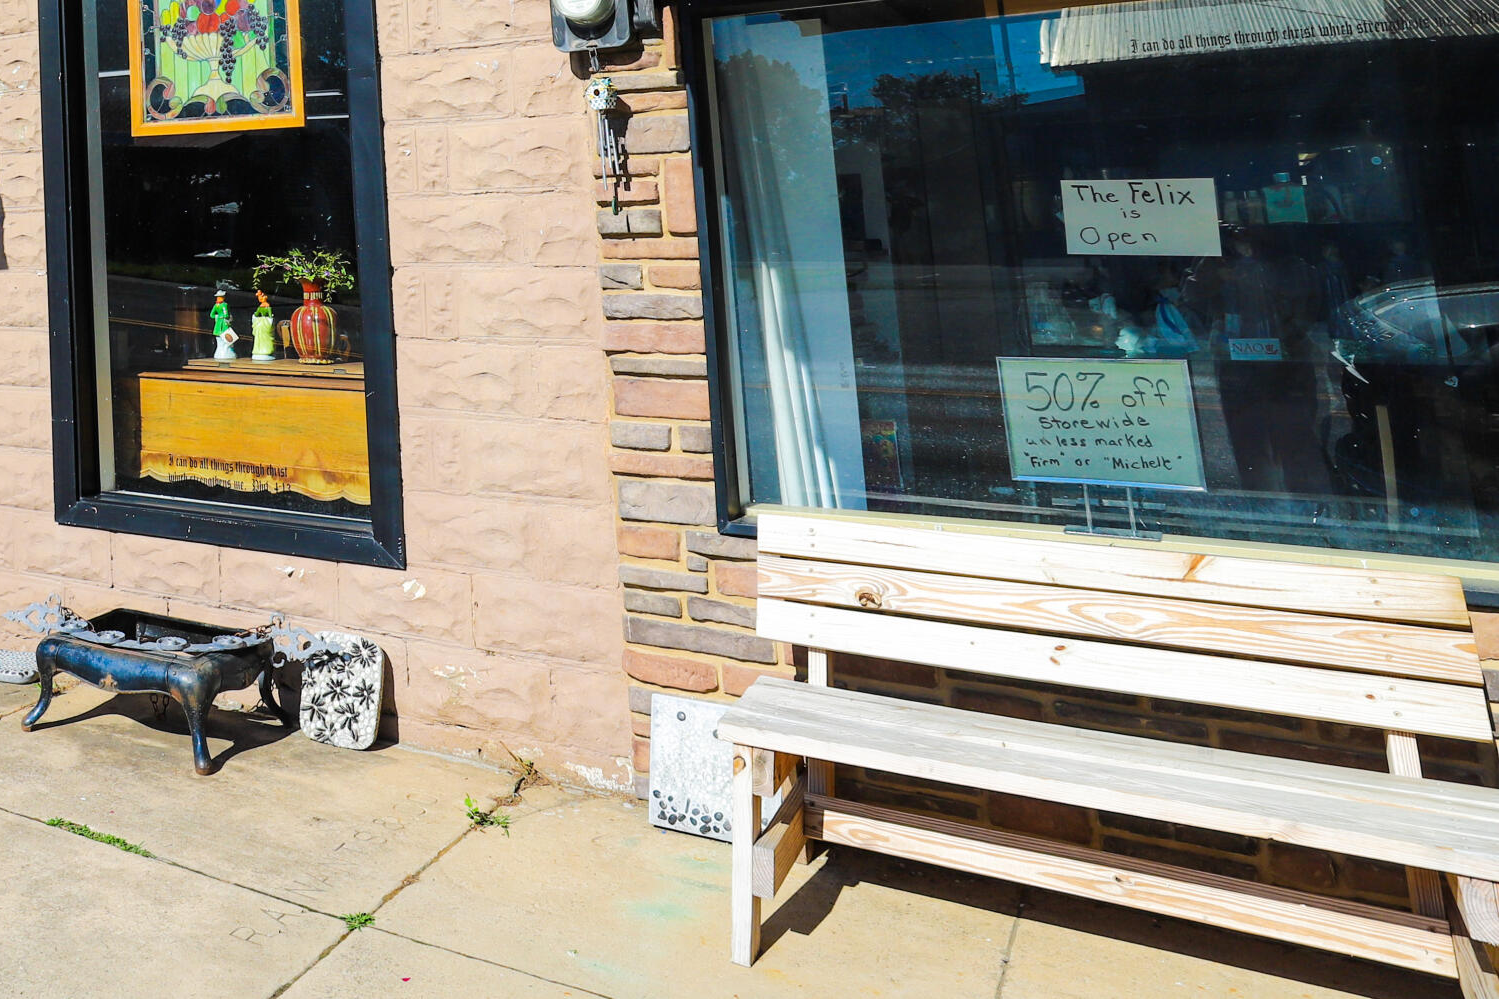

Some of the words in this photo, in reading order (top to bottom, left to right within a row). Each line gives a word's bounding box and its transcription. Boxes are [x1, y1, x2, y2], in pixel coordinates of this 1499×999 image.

[1130, 38, 1139, 54] I
[1142, 40, 1159, 53] can
[1162, 37, 1175, 50] do
[1178, 34, 1193, 49] all
[1195, 33, 1232, 49] things
[1234, 27, 1279, 45] through
[1282, 24, 1316, 41] christ
[1319, 22, 1353, 39] which
[1070, 184, 1119, 204] The
[1127, 181, 1196, 206] Felix
[1119, 207, 1141, 219] is
[1079, 226, 1158, 250] Open
[1025, 371, 1106, 412] 50%
[1121, 376, 1171, 408] off
[168, 453, 174, 466] I
[176, 457, 188, 468] can
[189, 456, 198, 468] do
[199, 458, 209, 470] all
[210, 459, 234, 475] things
[235, 461, 265, 477] through
[266, 464, 288, 478] christ
[1074, 457, 1092, 467] or
